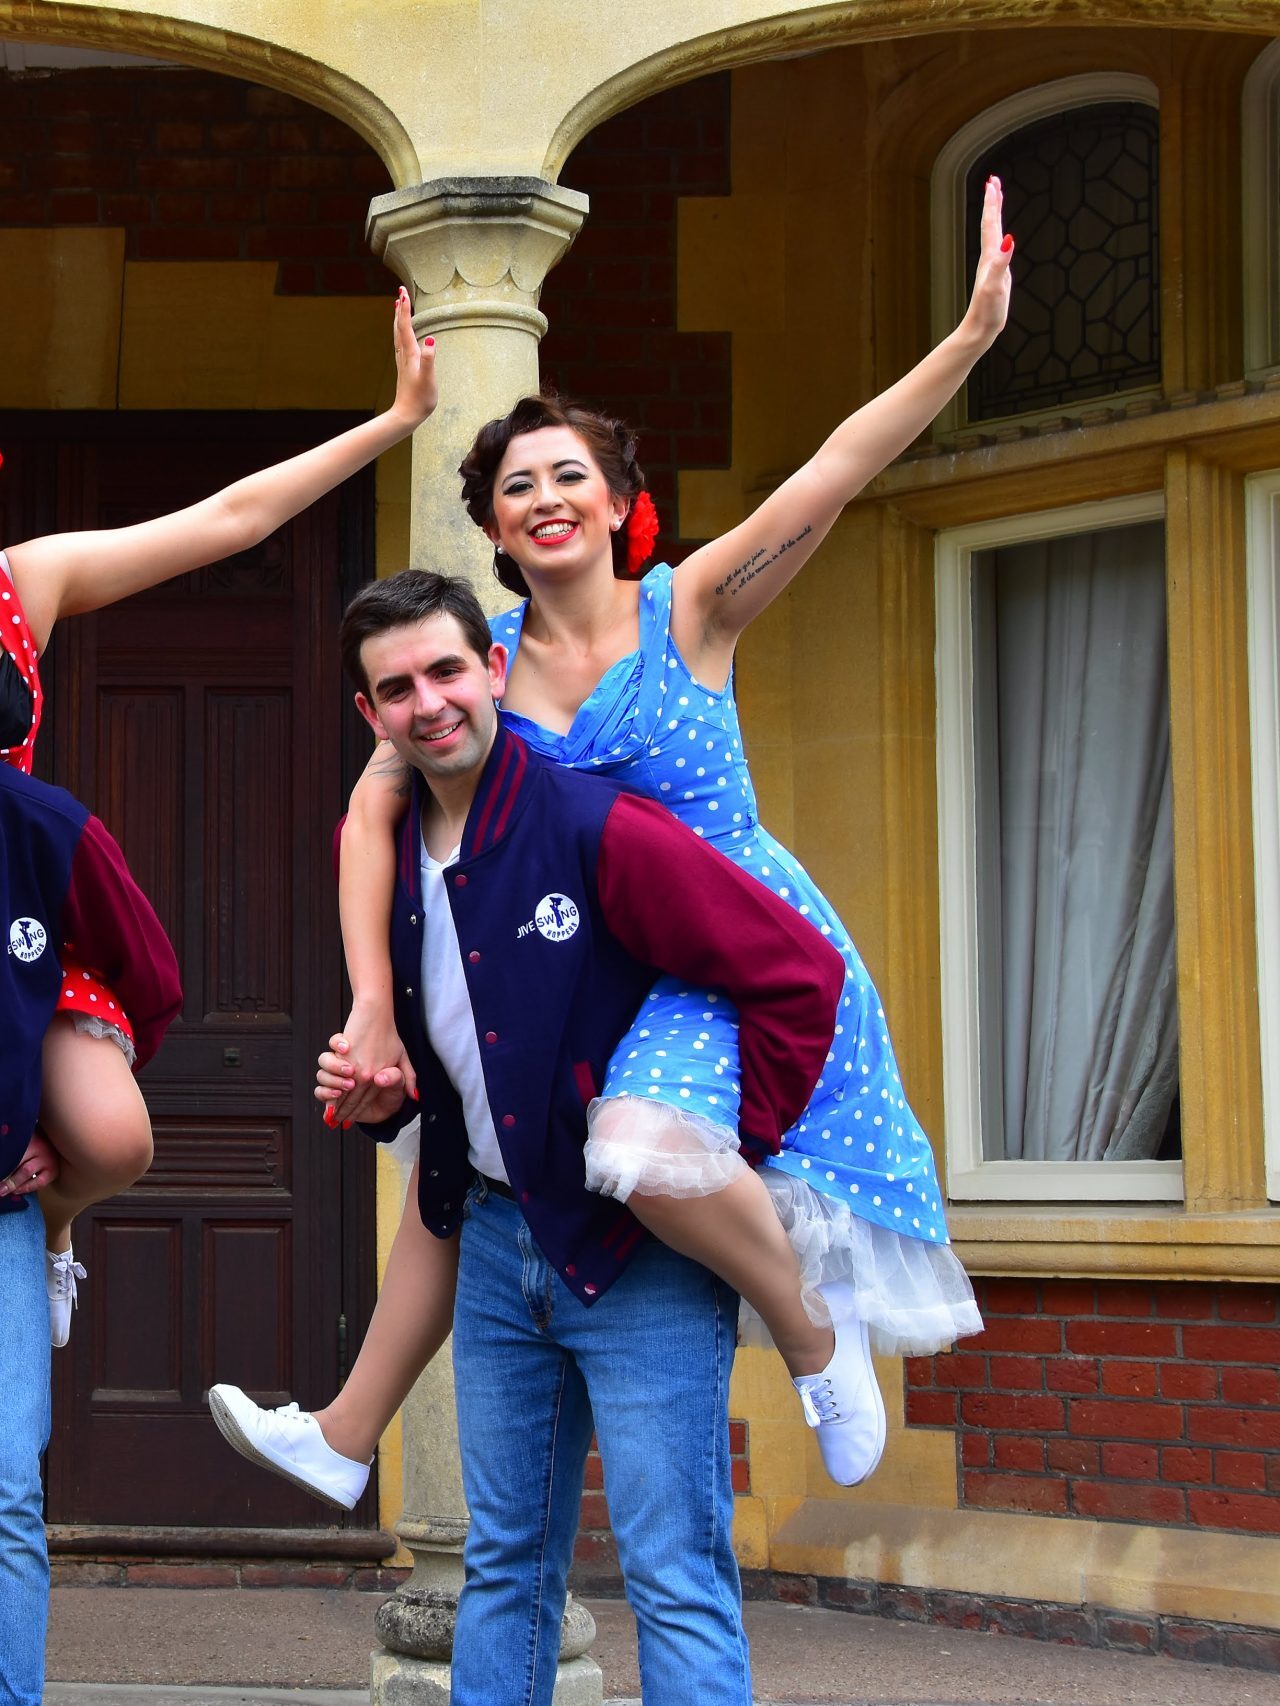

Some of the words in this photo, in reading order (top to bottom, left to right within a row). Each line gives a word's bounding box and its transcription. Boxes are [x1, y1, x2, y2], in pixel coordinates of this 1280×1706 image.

[725, 574, 734, 587] all
[517, 920, 536, 938] JIVE
[536, 897, 577, 928] SWING
[11, 921, 45, 951] SWING
